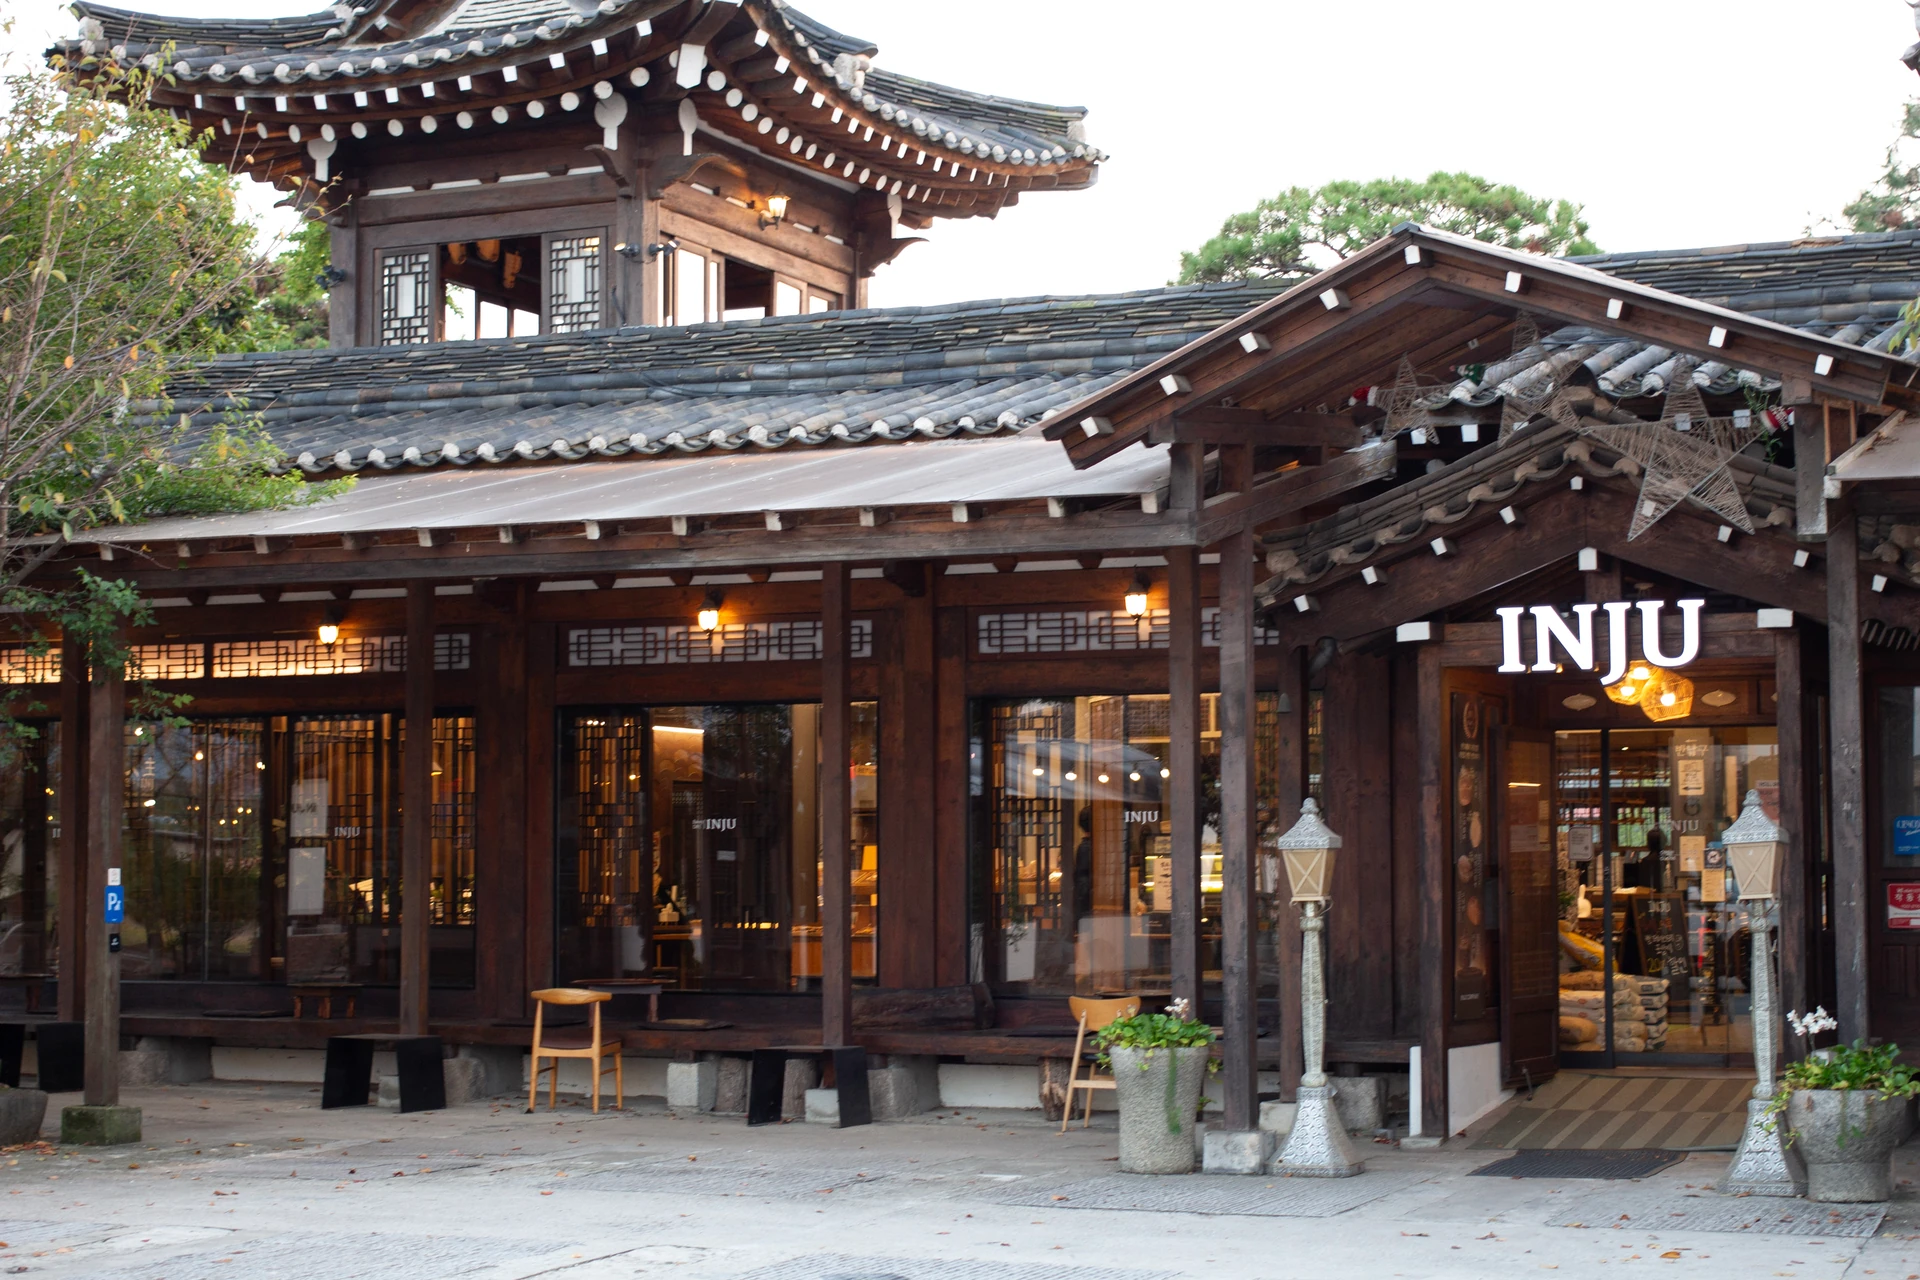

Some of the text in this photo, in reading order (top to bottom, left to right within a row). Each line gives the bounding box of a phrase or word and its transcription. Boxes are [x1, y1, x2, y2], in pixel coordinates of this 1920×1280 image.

[1496, 599, 1705, 686] INJU
[706, 818, 737, 832] INJU
[1124, 811, 1159, 825] INJU
[334, 826, 361, 839] INJU
[107, 892, 118, 911] P
